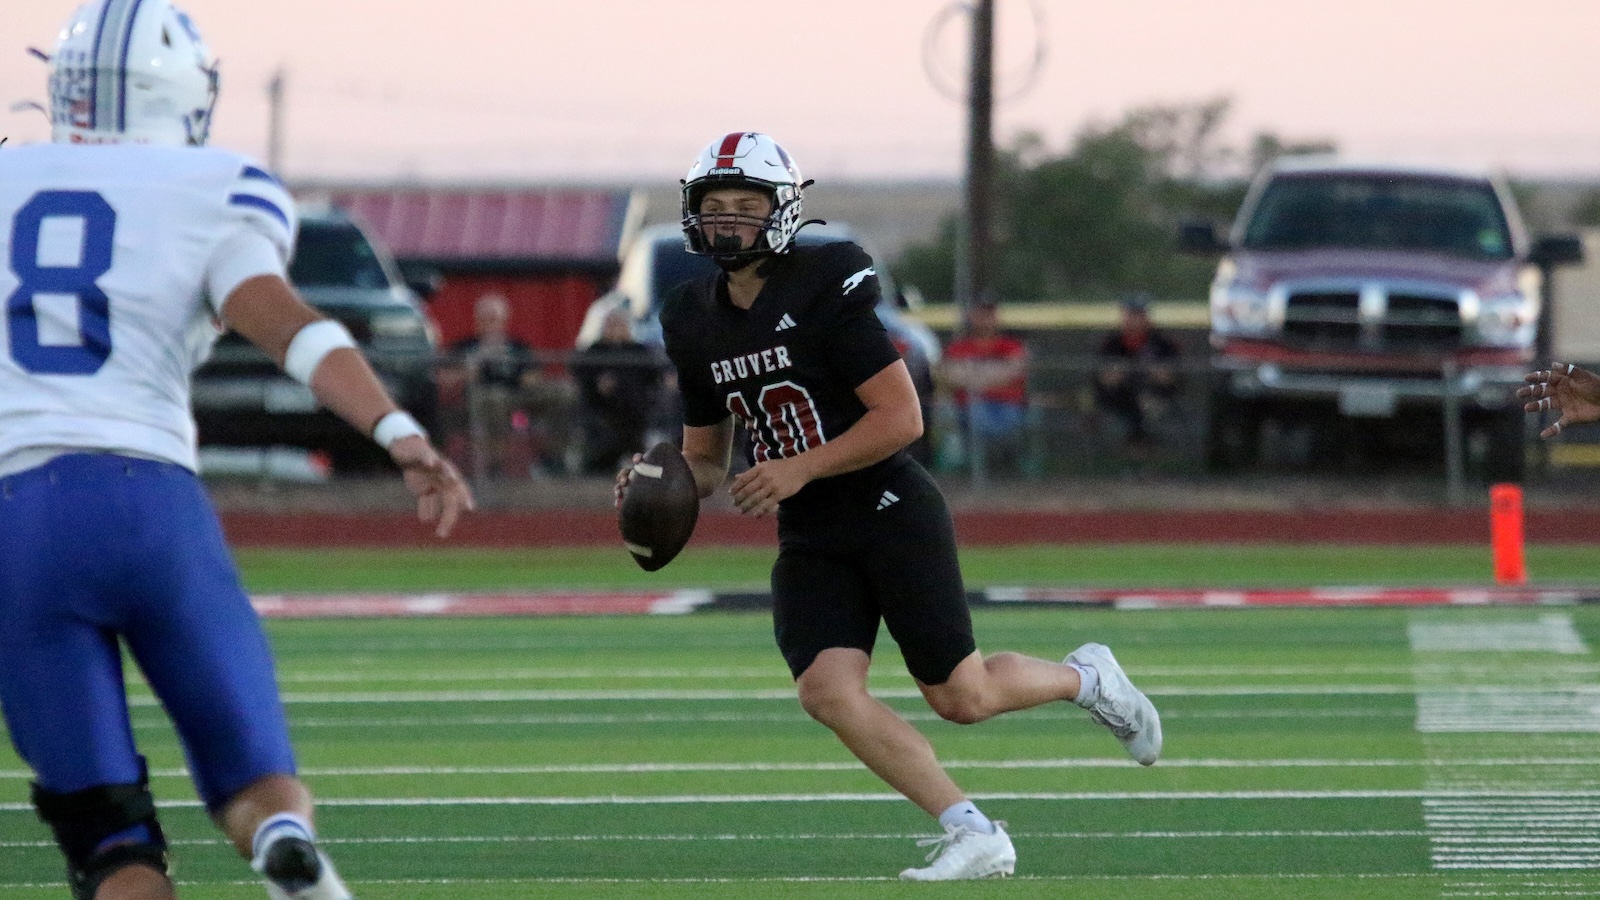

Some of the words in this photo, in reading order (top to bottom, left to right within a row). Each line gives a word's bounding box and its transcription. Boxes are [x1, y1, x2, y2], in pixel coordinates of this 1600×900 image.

[6, 189, 116, 376] 8
[710, 346, 792, 384] GRUVER
[726, 380, 826, 464] 10
